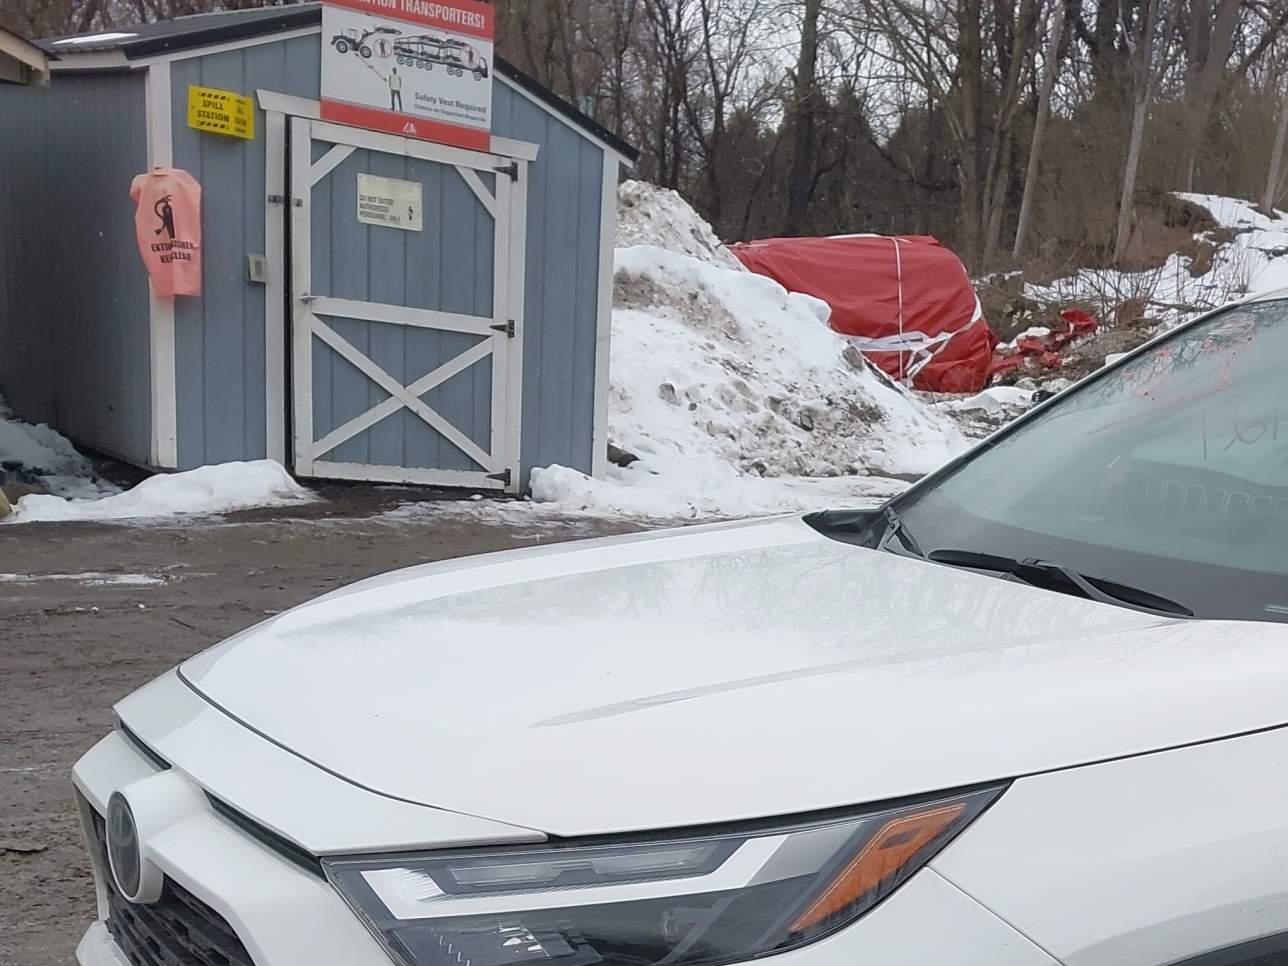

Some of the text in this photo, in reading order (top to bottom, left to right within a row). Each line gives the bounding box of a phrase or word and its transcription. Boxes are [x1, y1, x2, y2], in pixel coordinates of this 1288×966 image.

[401, 0, 485, 29] TRANSPORTERS!
[203, 100, 224, 110] SPILL
[414, 91, 487, 113] Safety Vest Required
[197, 110, 230, 122] STATION
